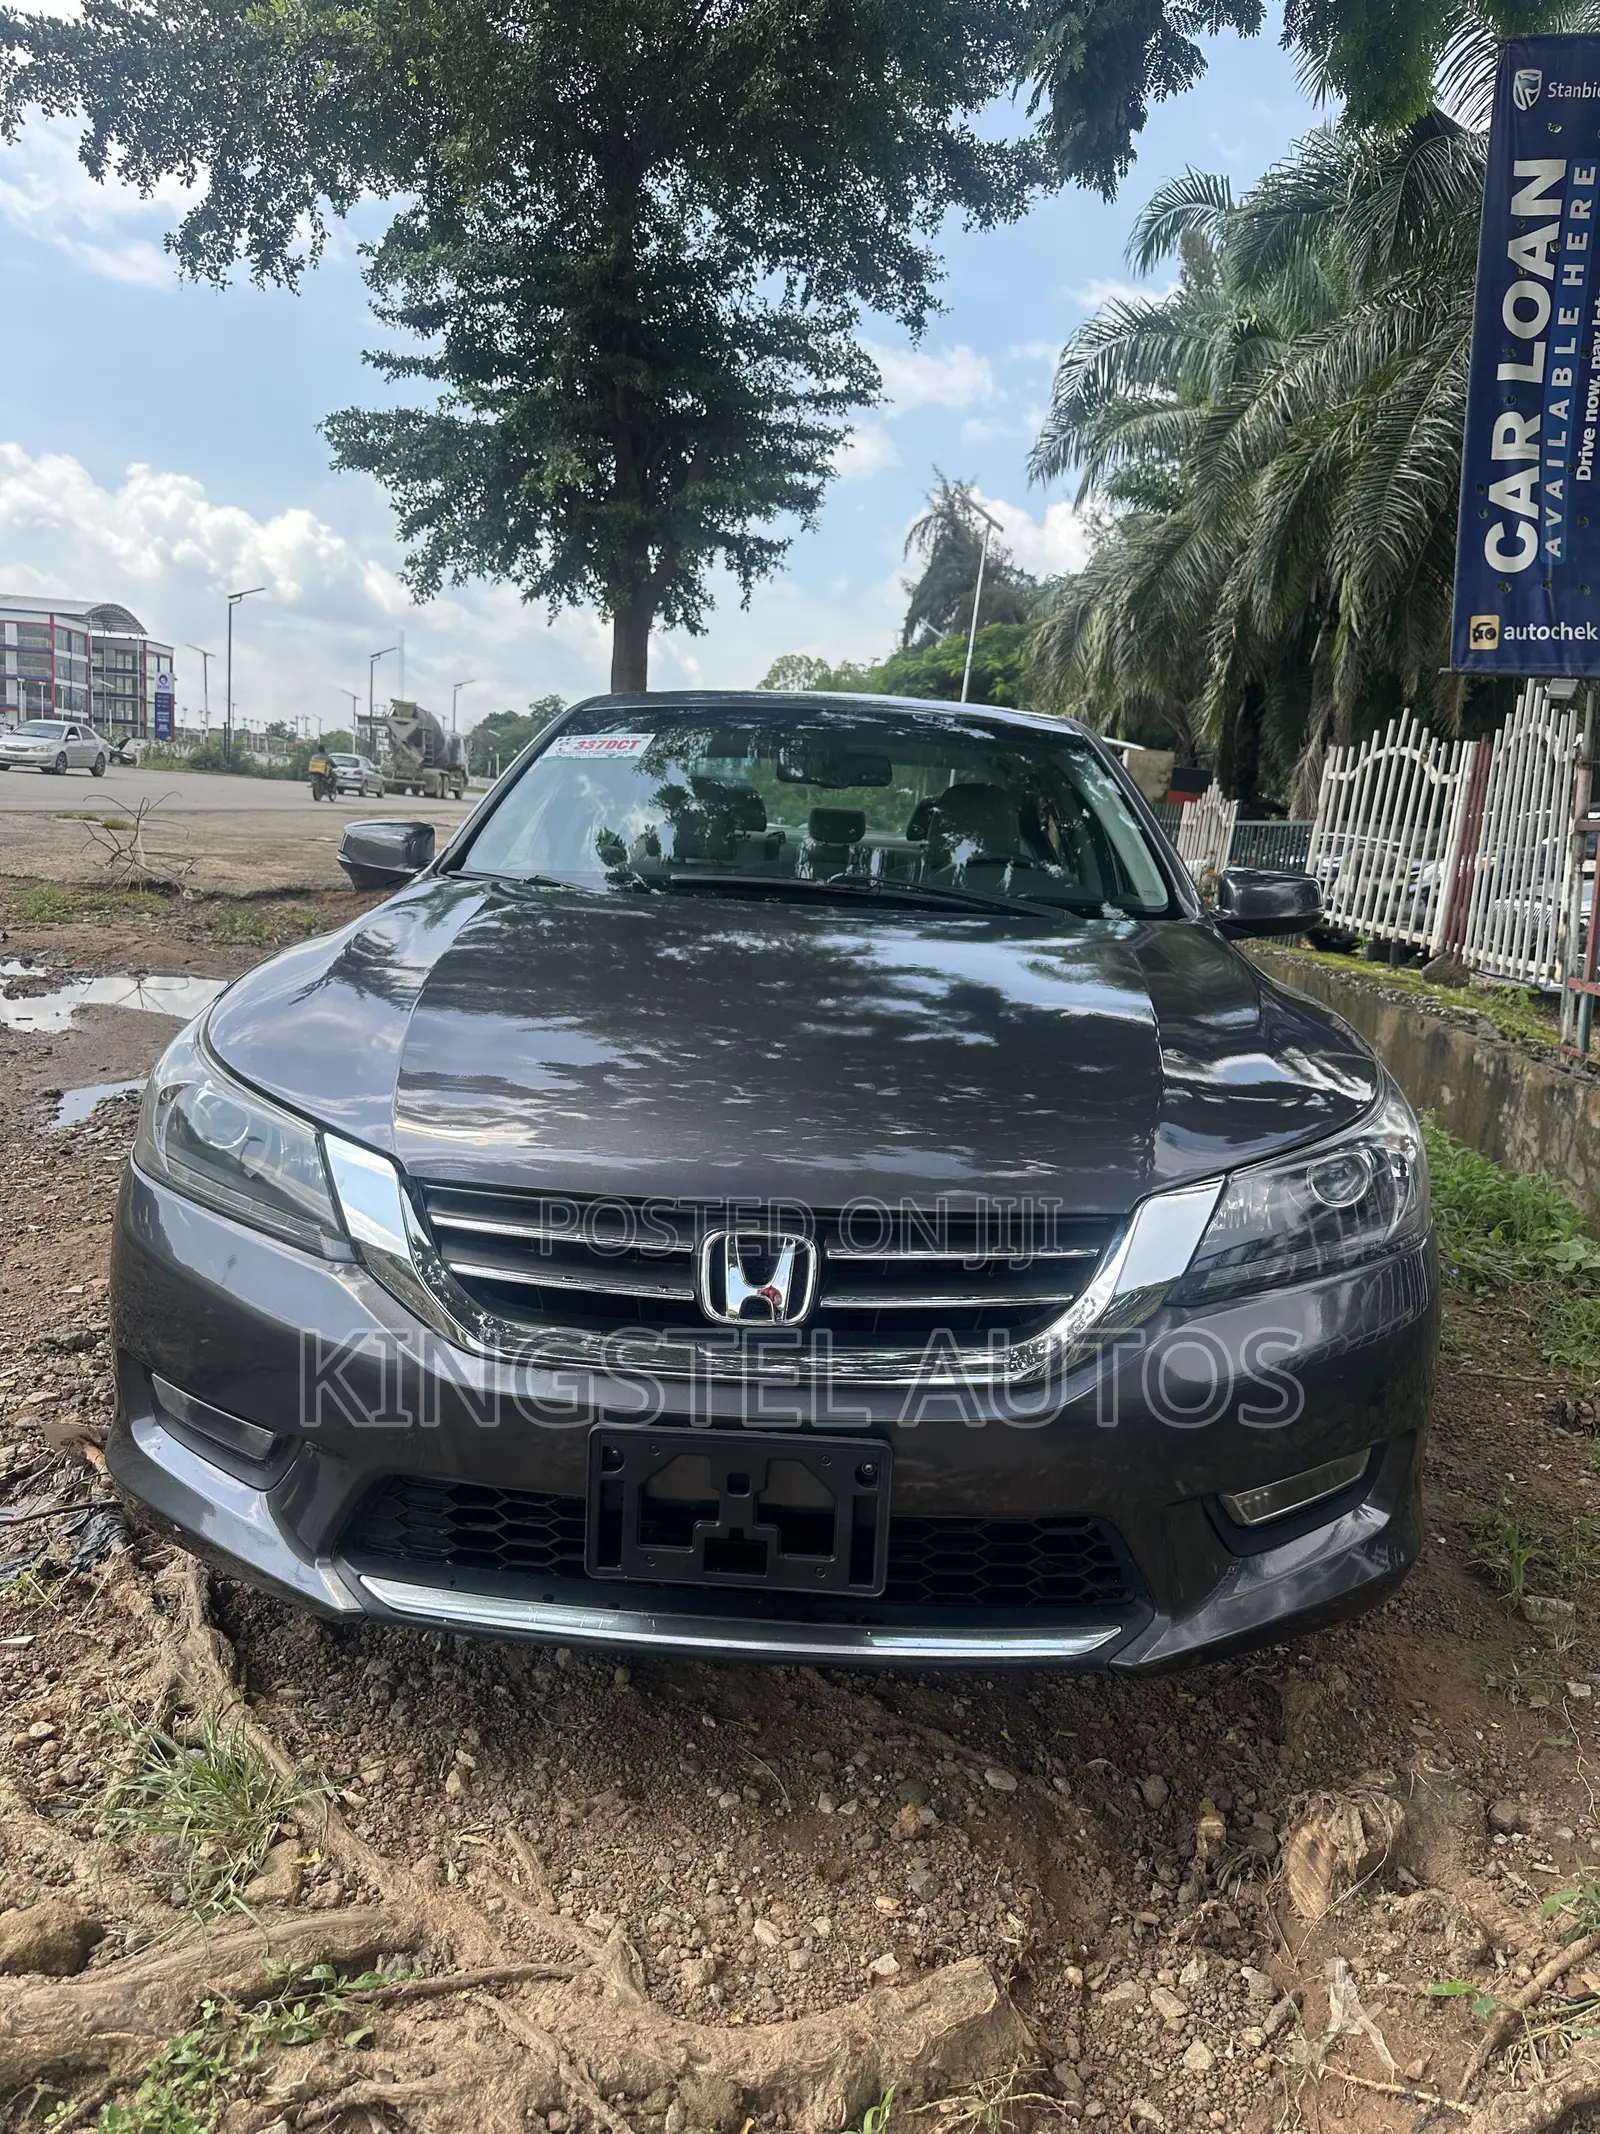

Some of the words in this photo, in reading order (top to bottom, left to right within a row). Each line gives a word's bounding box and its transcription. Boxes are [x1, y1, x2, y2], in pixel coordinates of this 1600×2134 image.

[1497, 159, 1567, 383] LOAN
[1562, 166, 1597, 286] HERE
[1484, 411, 1541, 573] CAR
[1545, 306, 1580, 558] AVAILABLE
[1576, 427, 1596, 481] Drive
[1503, 621, 1599, 640] autochek
